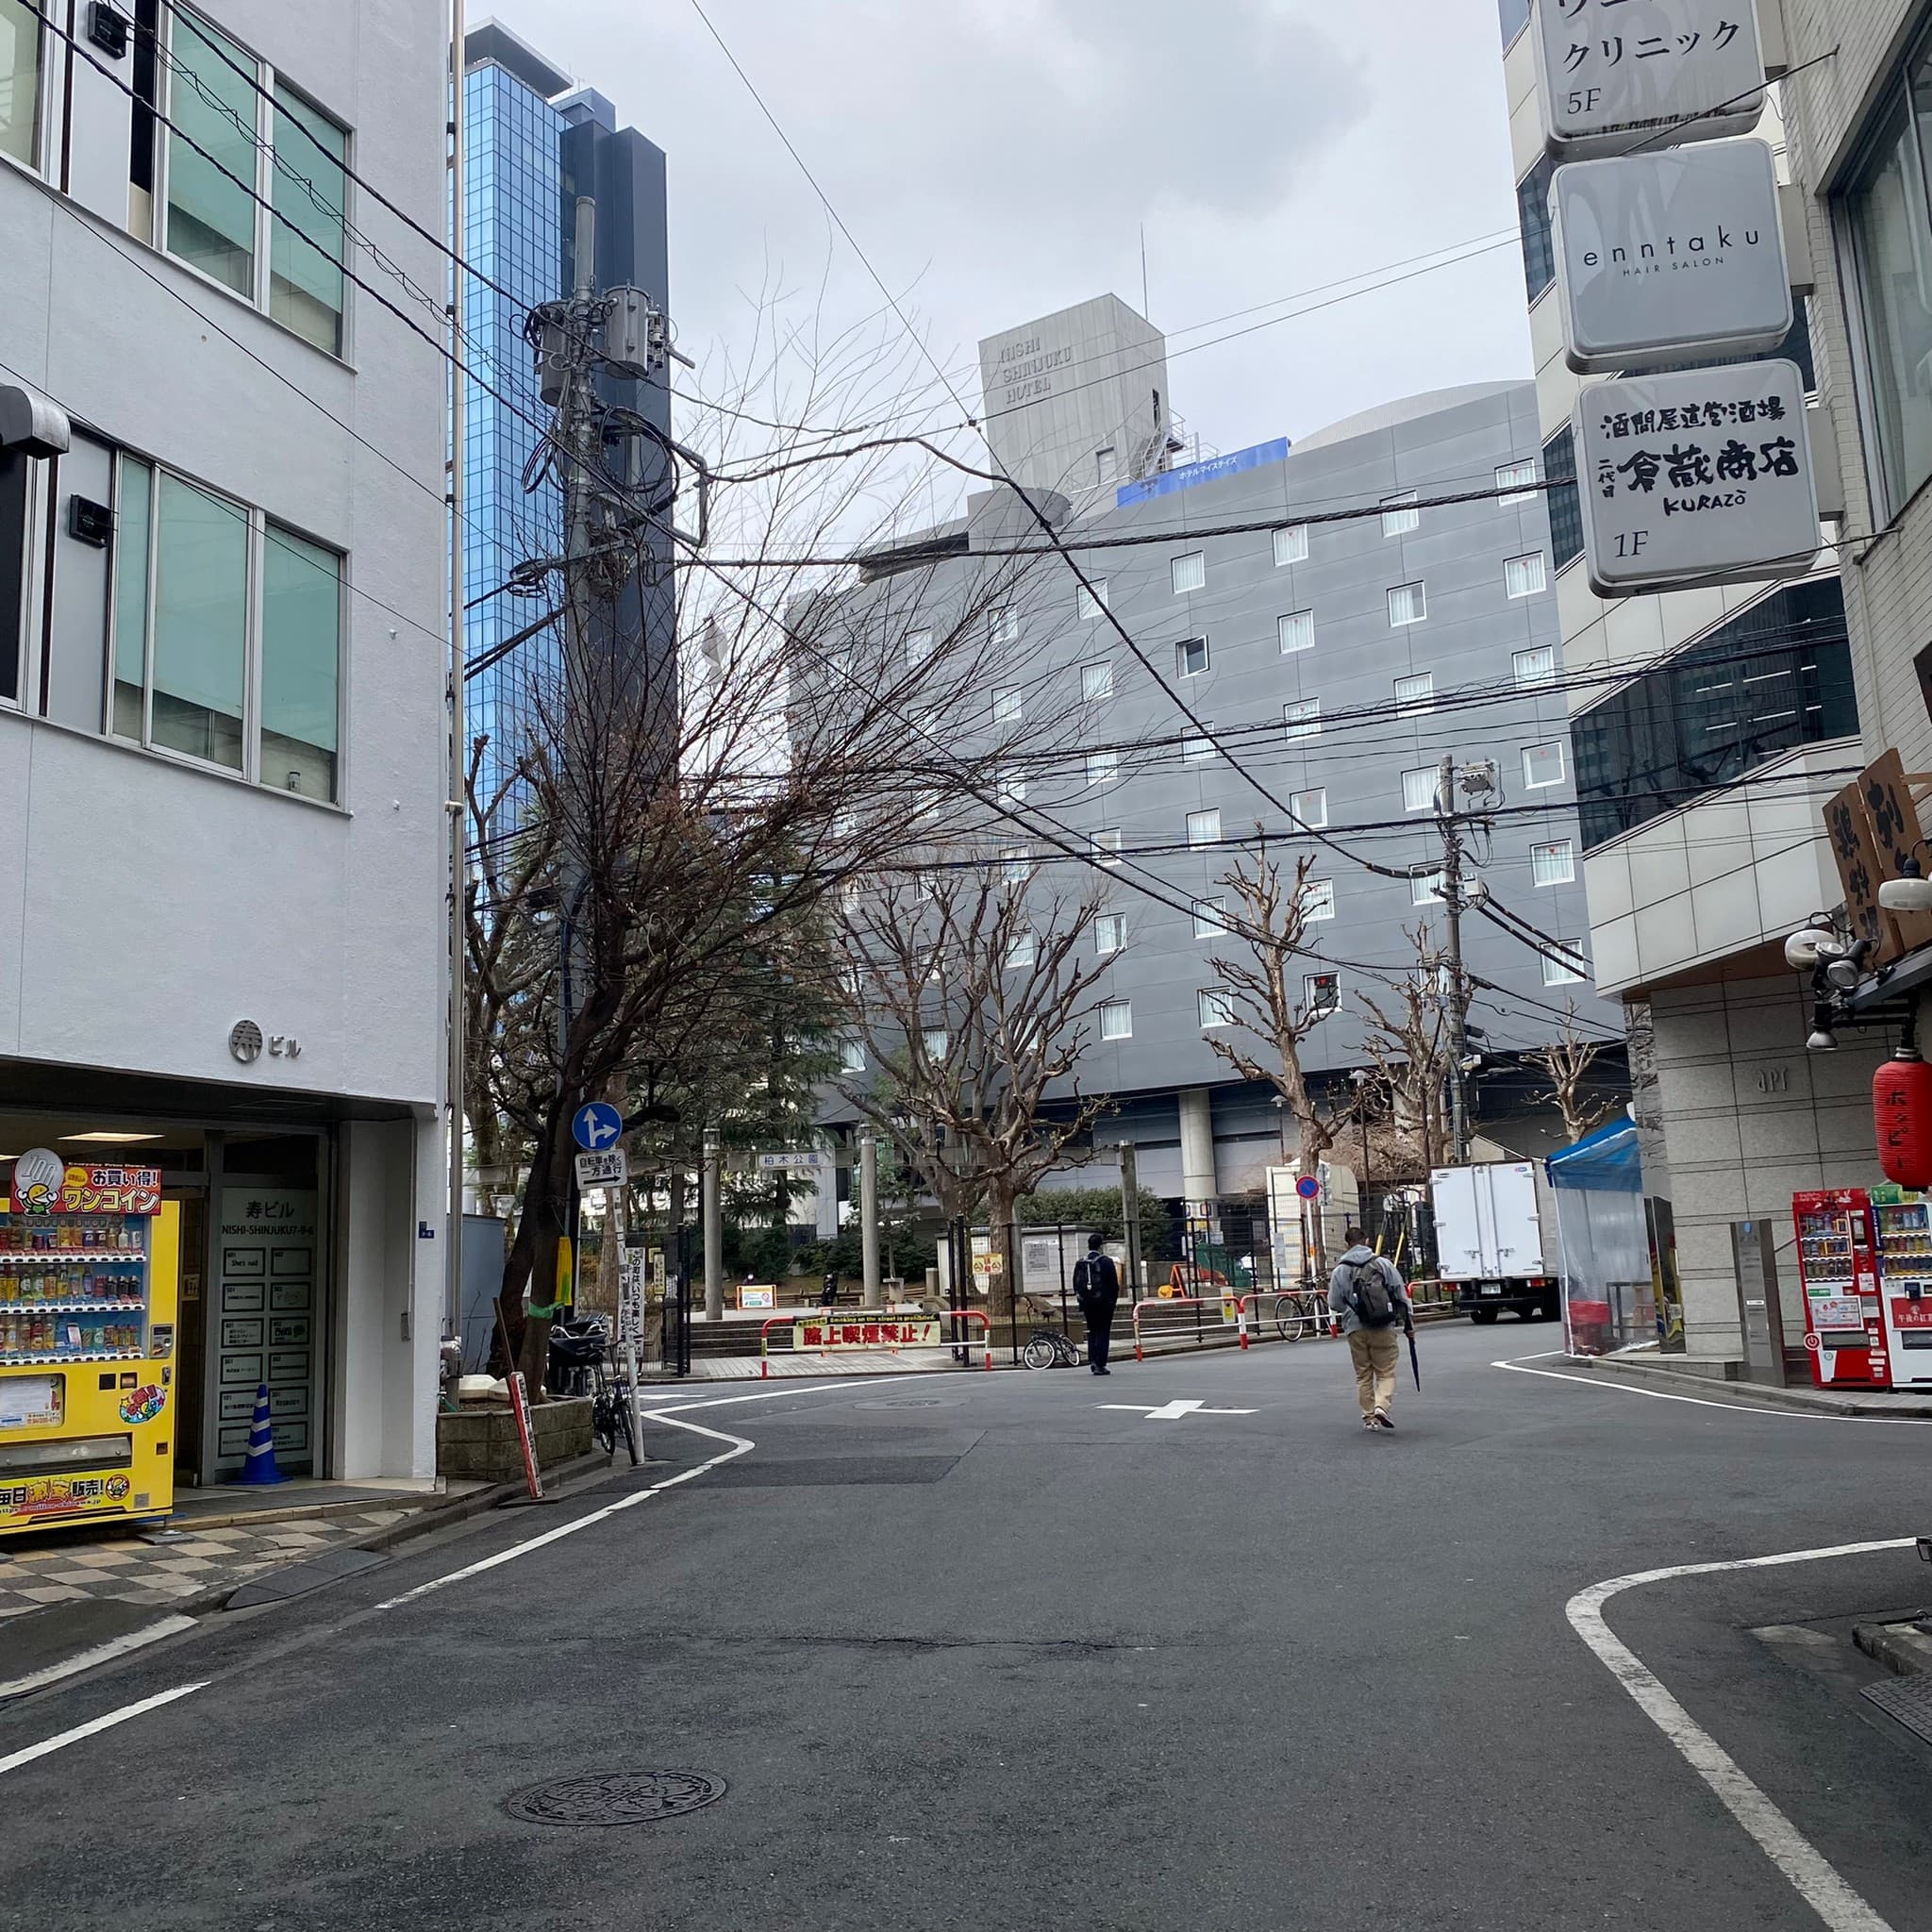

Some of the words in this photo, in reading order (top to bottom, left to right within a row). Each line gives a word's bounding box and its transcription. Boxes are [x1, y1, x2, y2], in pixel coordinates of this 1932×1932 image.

[1563, 21, 1740, 74] クリニック
[1567, 88, 1601, 114] 5F
[1584, 225, 1758, 266] enntaku
[1623, 264, 1660, 276] HAIR
[1672, 257, 1724, 271] SALON
[1006, 376, 1051, 405] HOTEL
[1614, 530, 1649, 558] 1F
[581, 1165, 622, 1176] 一方通行
[764, 1155, 818, 1166] 柏木公園
[92, 1169, 158, 1187] お買い得!
[63, 1189, 158, 1212] ワンコイン
[245, 1200, 295, 1219] 寿ビル
[804, 1324, 930, 1345] 路上喫煙禁止!
